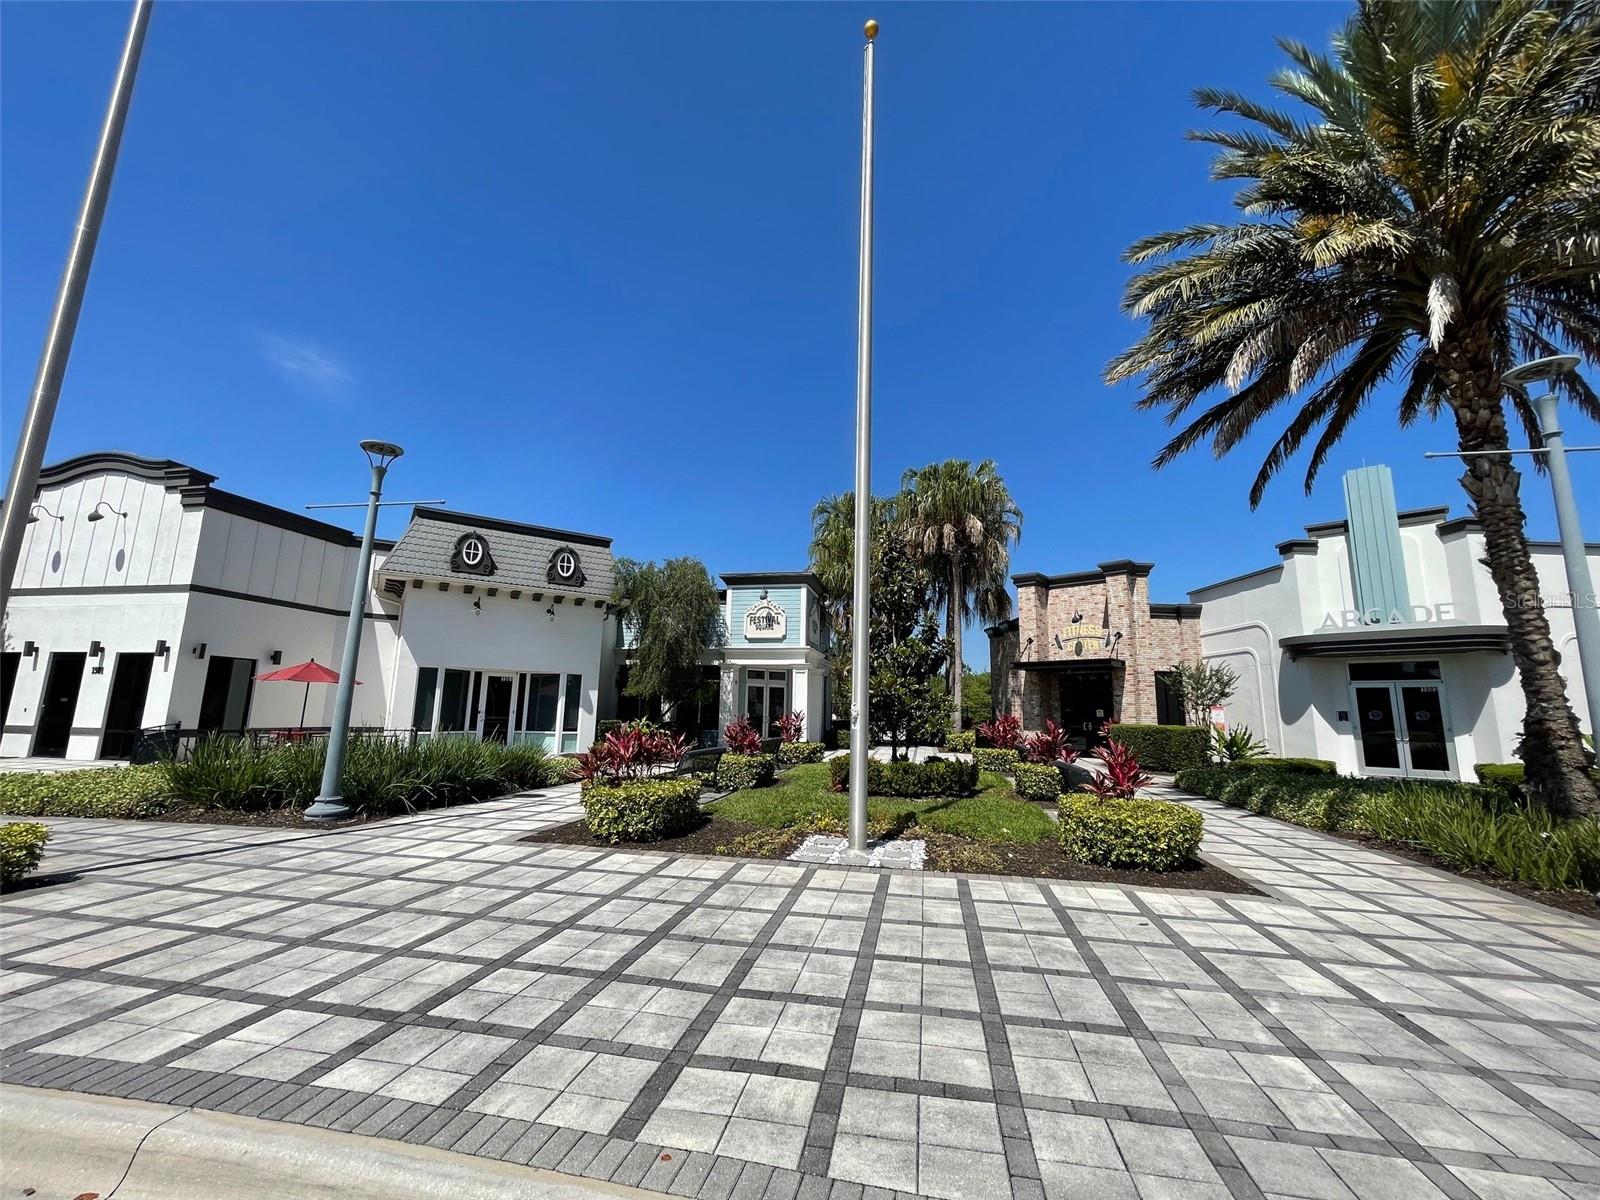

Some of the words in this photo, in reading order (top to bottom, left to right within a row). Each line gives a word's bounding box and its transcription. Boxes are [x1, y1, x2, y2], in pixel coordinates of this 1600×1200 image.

[749, 615, 781, 626] FESTIVAL
[1321, 602, 1456, 629] ARCADE
[1062, 624, 1104, 638] FITNESS
[1067, 638, 1101, 652] CTER
